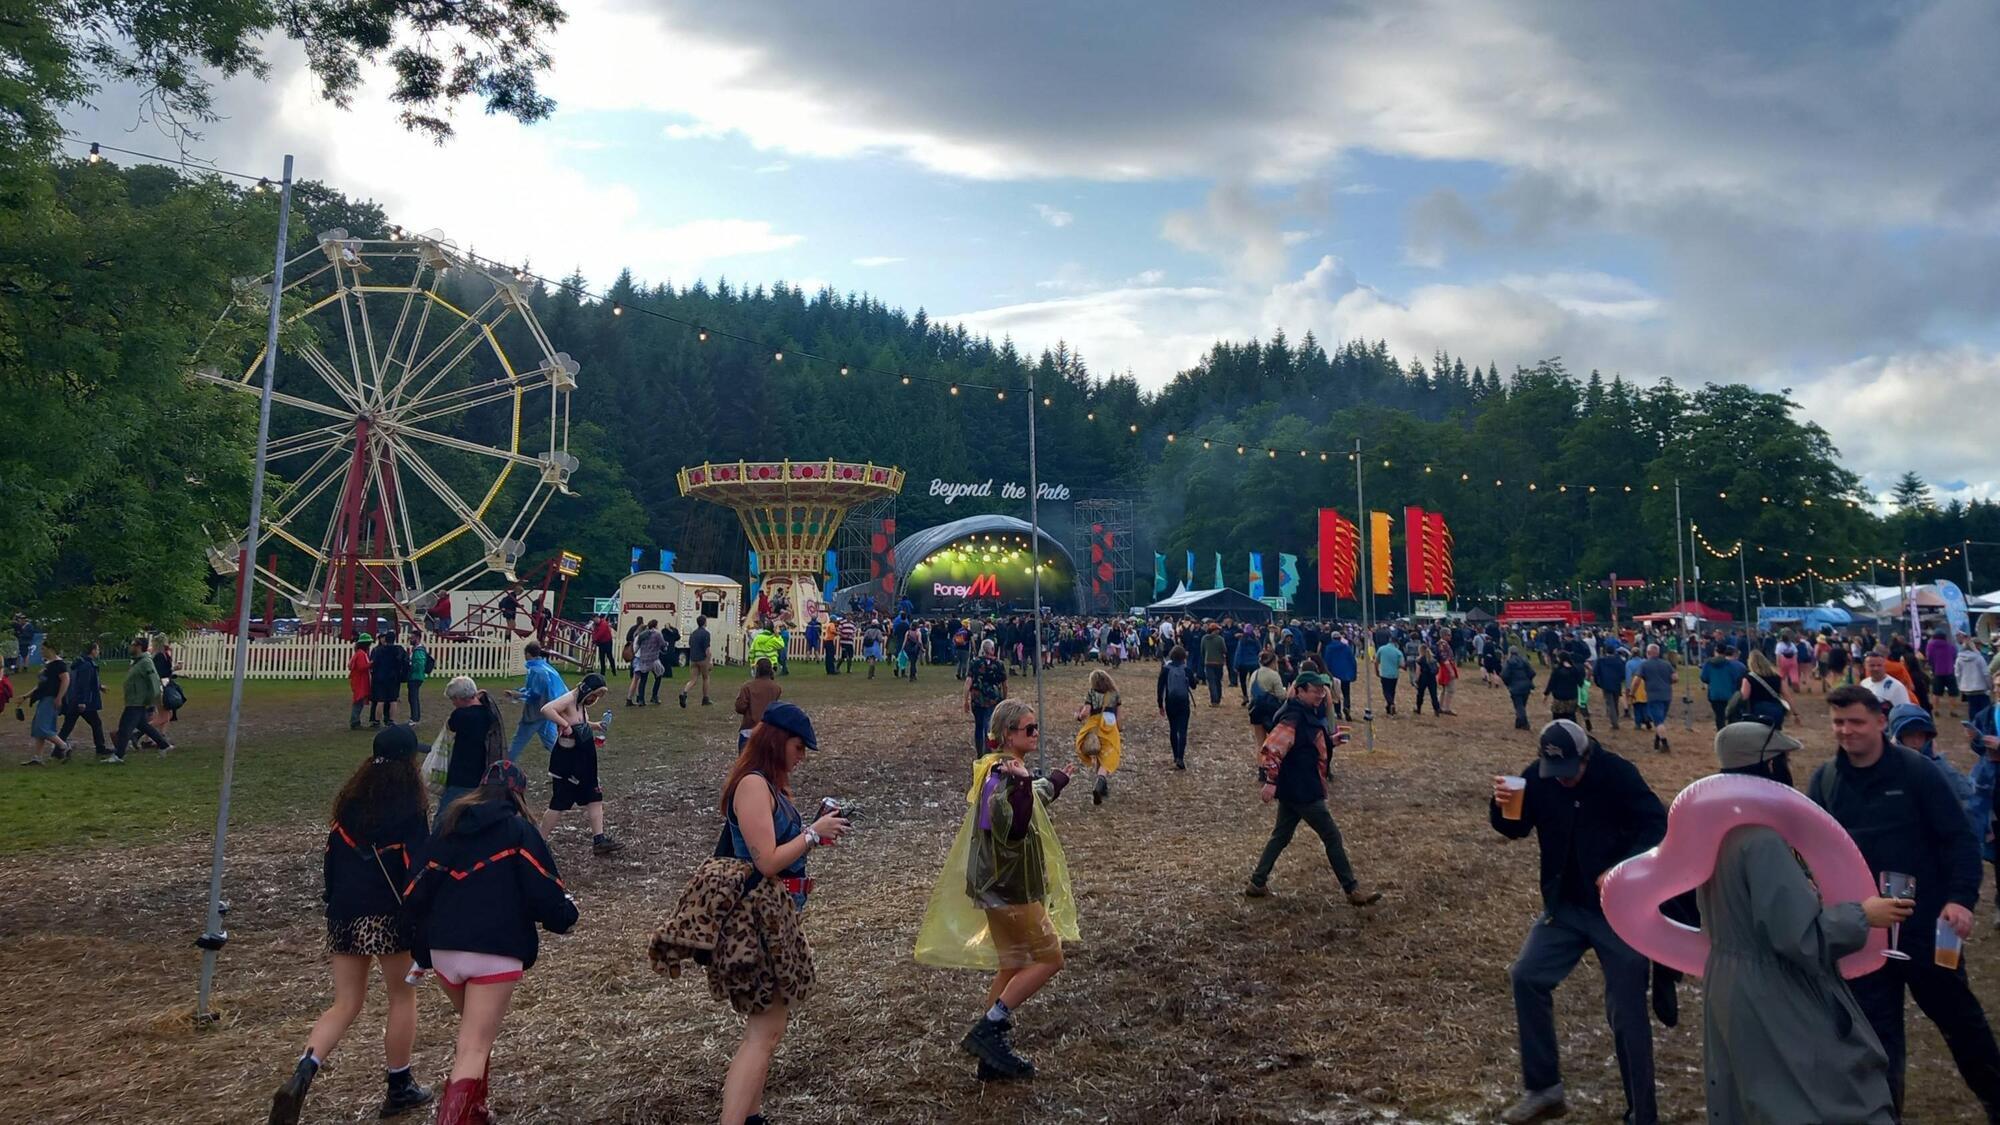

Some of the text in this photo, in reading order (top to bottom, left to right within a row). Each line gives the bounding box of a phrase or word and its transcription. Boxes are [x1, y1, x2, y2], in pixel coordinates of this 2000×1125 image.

[929, 478, 1070, 504] Beyond the Pale
